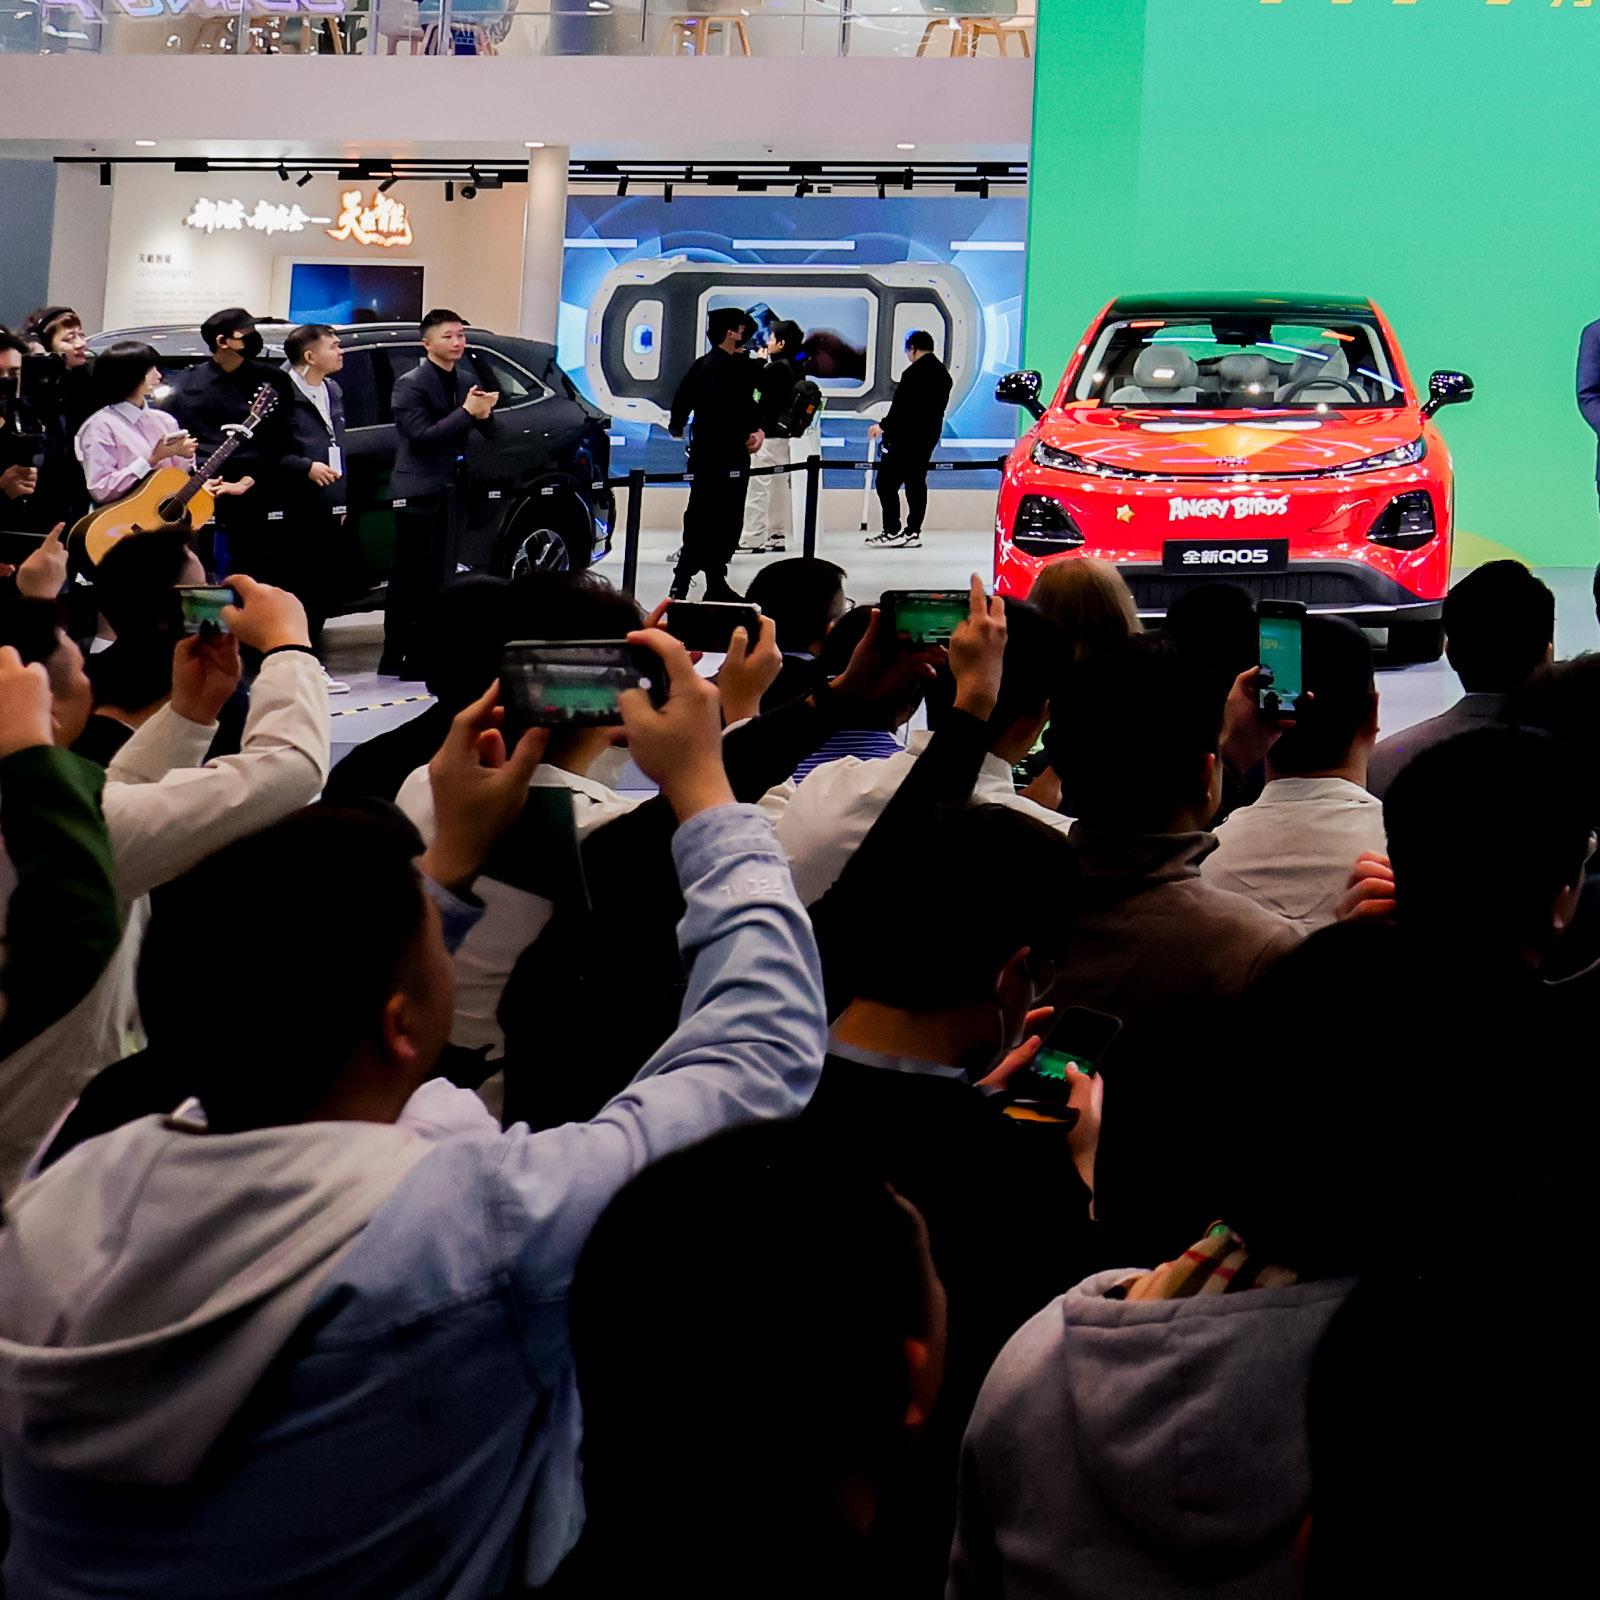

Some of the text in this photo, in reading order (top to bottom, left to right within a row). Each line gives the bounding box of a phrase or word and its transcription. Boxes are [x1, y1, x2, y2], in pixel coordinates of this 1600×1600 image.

[1168, 494, 1290, 522] ANGRY BIRDS
[1182, 549, 1269, 565] 全新Q05
